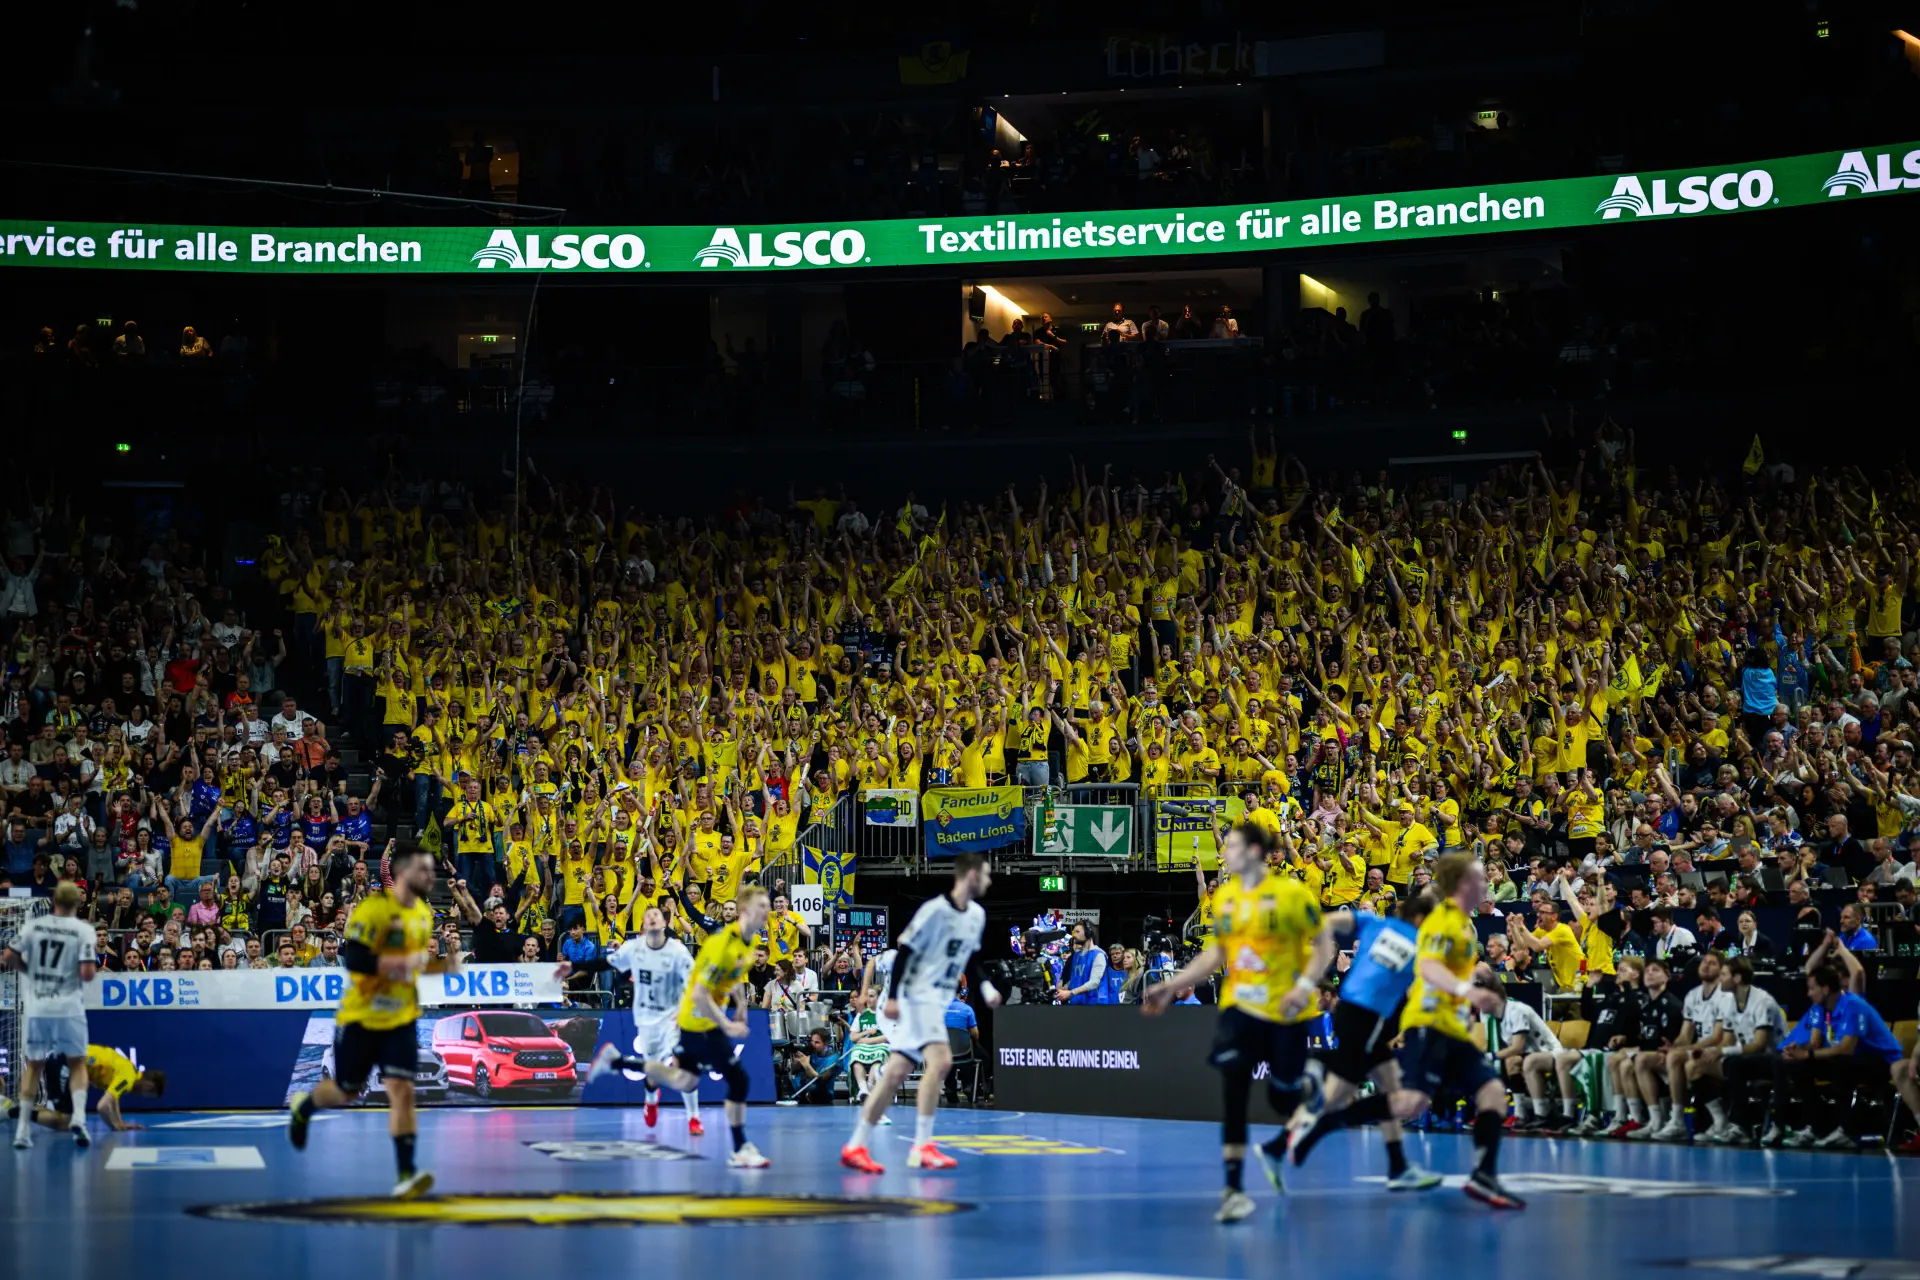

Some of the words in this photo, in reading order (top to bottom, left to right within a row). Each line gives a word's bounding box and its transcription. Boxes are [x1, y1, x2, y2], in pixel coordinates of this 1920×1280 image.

[1597, 169, 1775, 219] ALSCO
[919, 213, 1225, 253] Textilmietservice
[1236, 209, 1290, 239] für
[1301, 203, 1361, 236] alle
[1374, 192, 1545, 230] Branchen
[0, 227, 95, 258] rvice
[108, 230, 163, 259] für
[175, 233, 237, 261] alle
[251, 234, 421, 262] Branchen
[472, 229, 646, 269] ALSCO
[695, 227, 866, 267] ALSCO
[940, 792, 999, 809] Fanclub
[937, 831, 976, 844] Baden
[980, 824, 1015, 839] Lions
[793, 897, 822, 912] 106
[39, 939, 65, 969] 17
[103, 978, 174, 1006] DKB
[178, 978, 194, 986] Das
[178, 988, 199, 996] kann
[275, 974, 344, 1002] DKB
[444, 971, 509, 997] DKB
[999, 1048, 1025, 1066] TESTE
[1027, 1048, 1055, 1067] EINEN.
[1057, 1049, 1100, 1068] GEWINNE
[1102, 1050, 1140, 1070] DEINEN.
